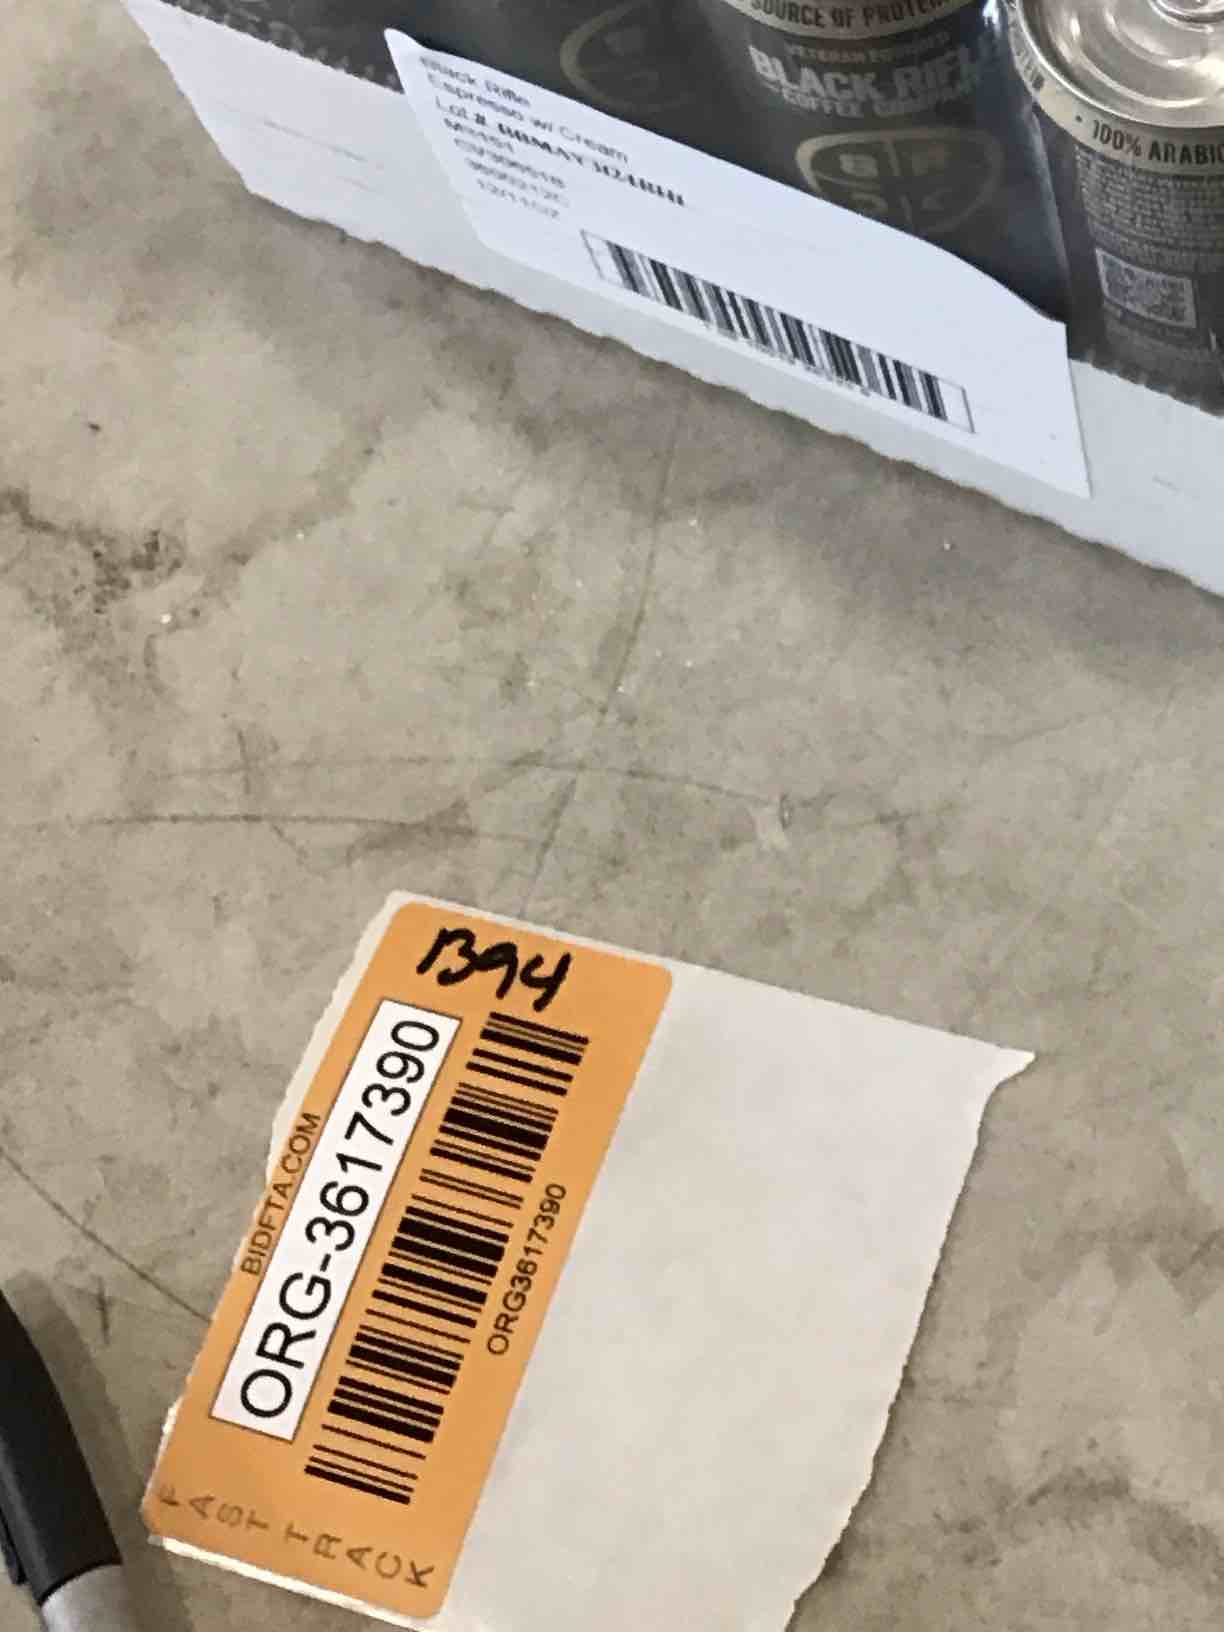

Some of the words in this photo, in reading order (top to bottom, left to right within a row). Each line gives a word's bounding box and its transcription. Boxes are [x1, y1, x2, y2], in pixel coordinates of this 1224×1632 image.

[831, 6, 857, 29] OF
[559, 125, 629, 165] Cream
[1091, 119, 1142, 157] 100%
[239, 1111, 321, 1276] BIDFTA.COM
[239, 1018, 442, 1420] ORG-3617390
[486, 1183, 567, 1356] ORG3617390
[283, 1522, 436, 1589] TRACK
